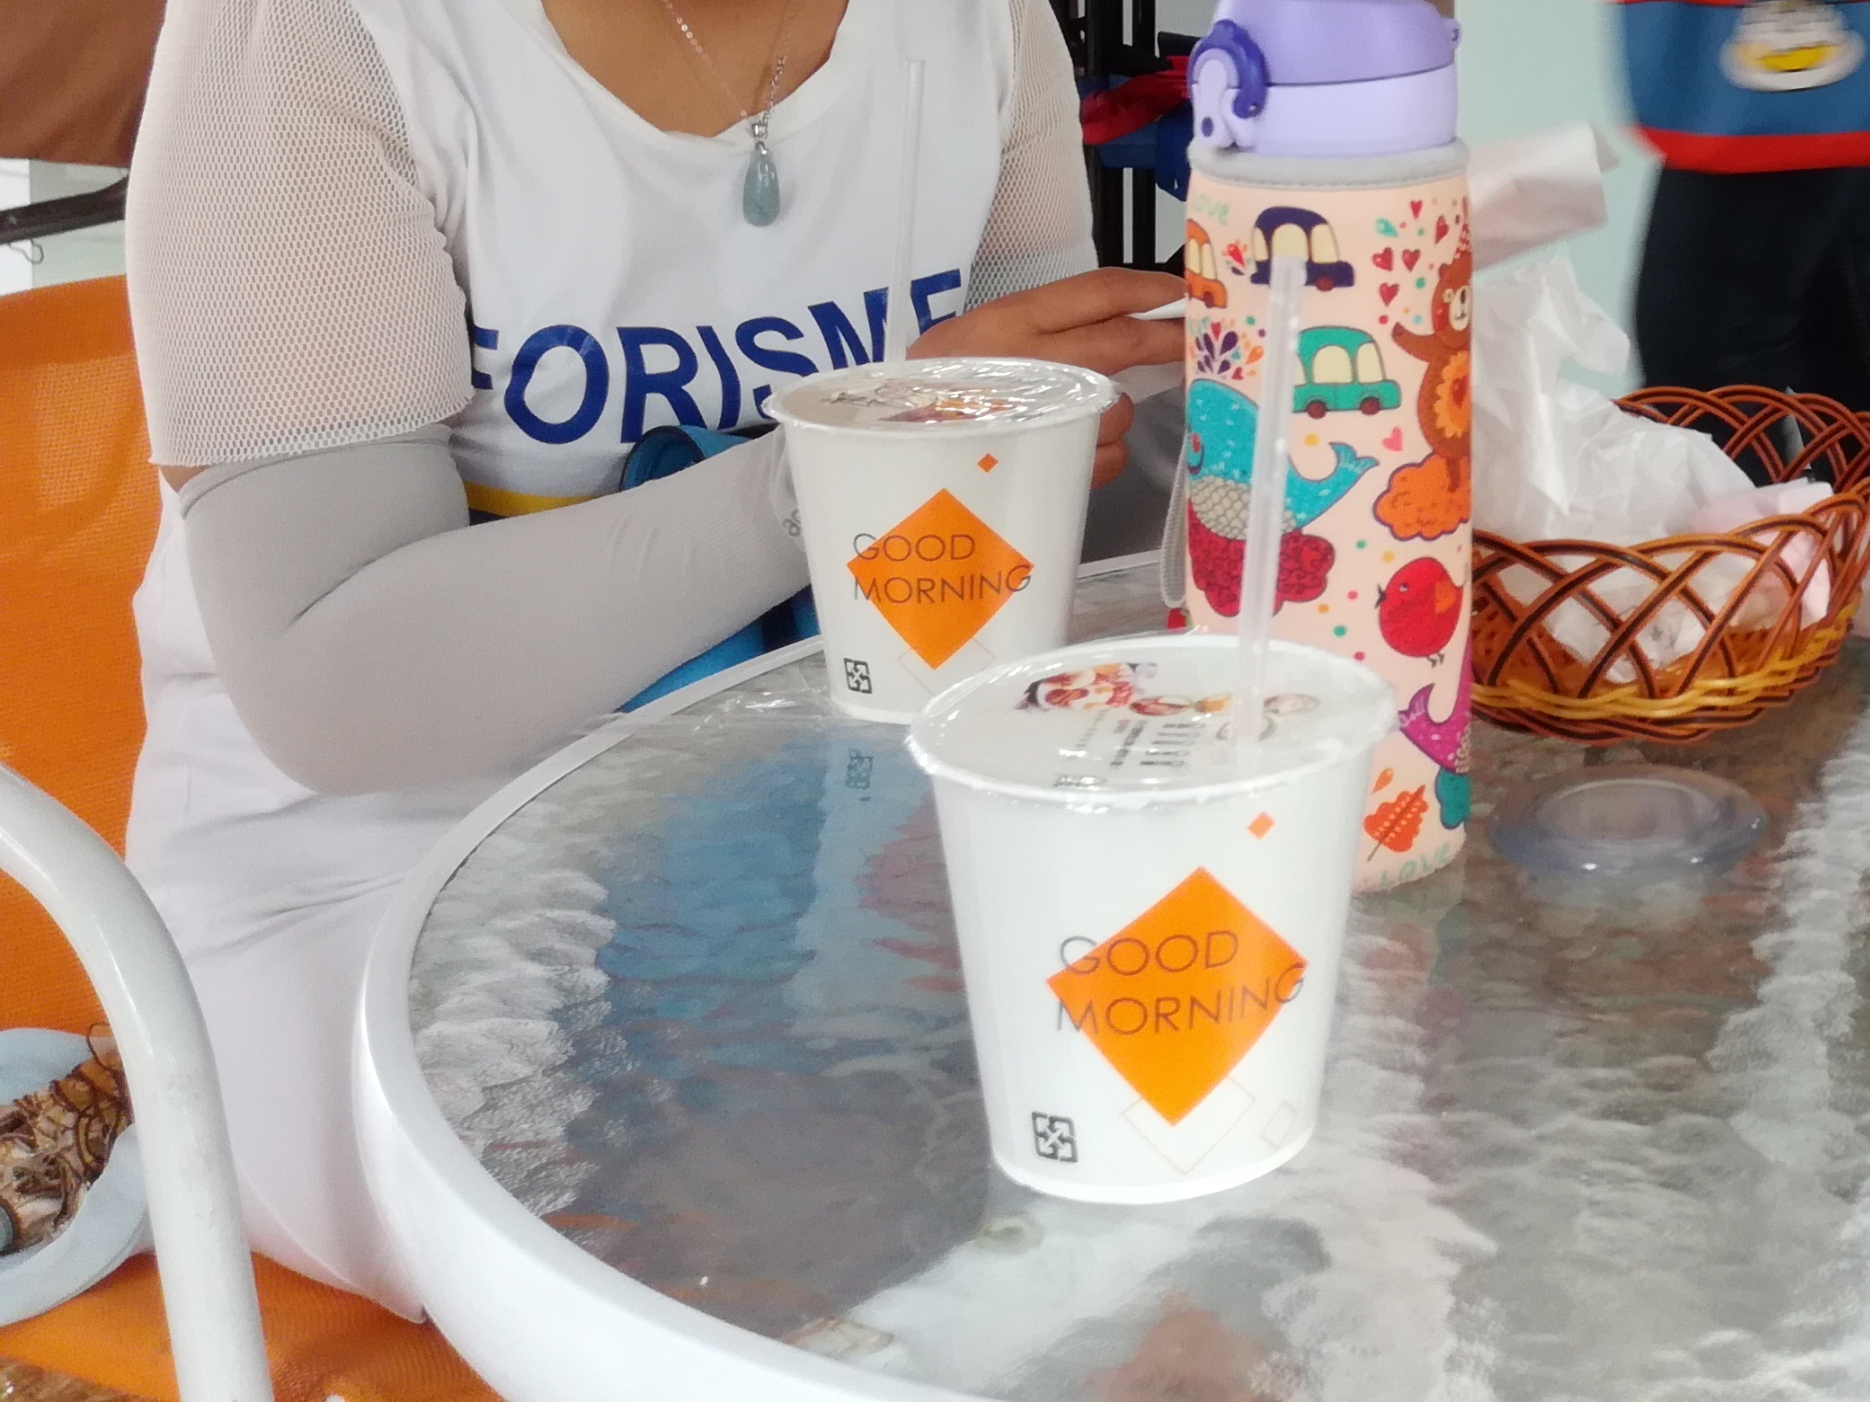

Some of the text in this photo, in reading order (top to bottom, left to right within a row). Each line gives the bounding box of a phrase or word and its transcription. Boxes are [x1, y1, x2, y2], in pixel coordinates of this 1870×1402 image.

[852, 532, 976, 562] GOOD
[853, 563, 1032, 604] MORNING
[1059, 929, 1240, 977] GOOD
[1056, 962, 1306, 1036] MORNING
